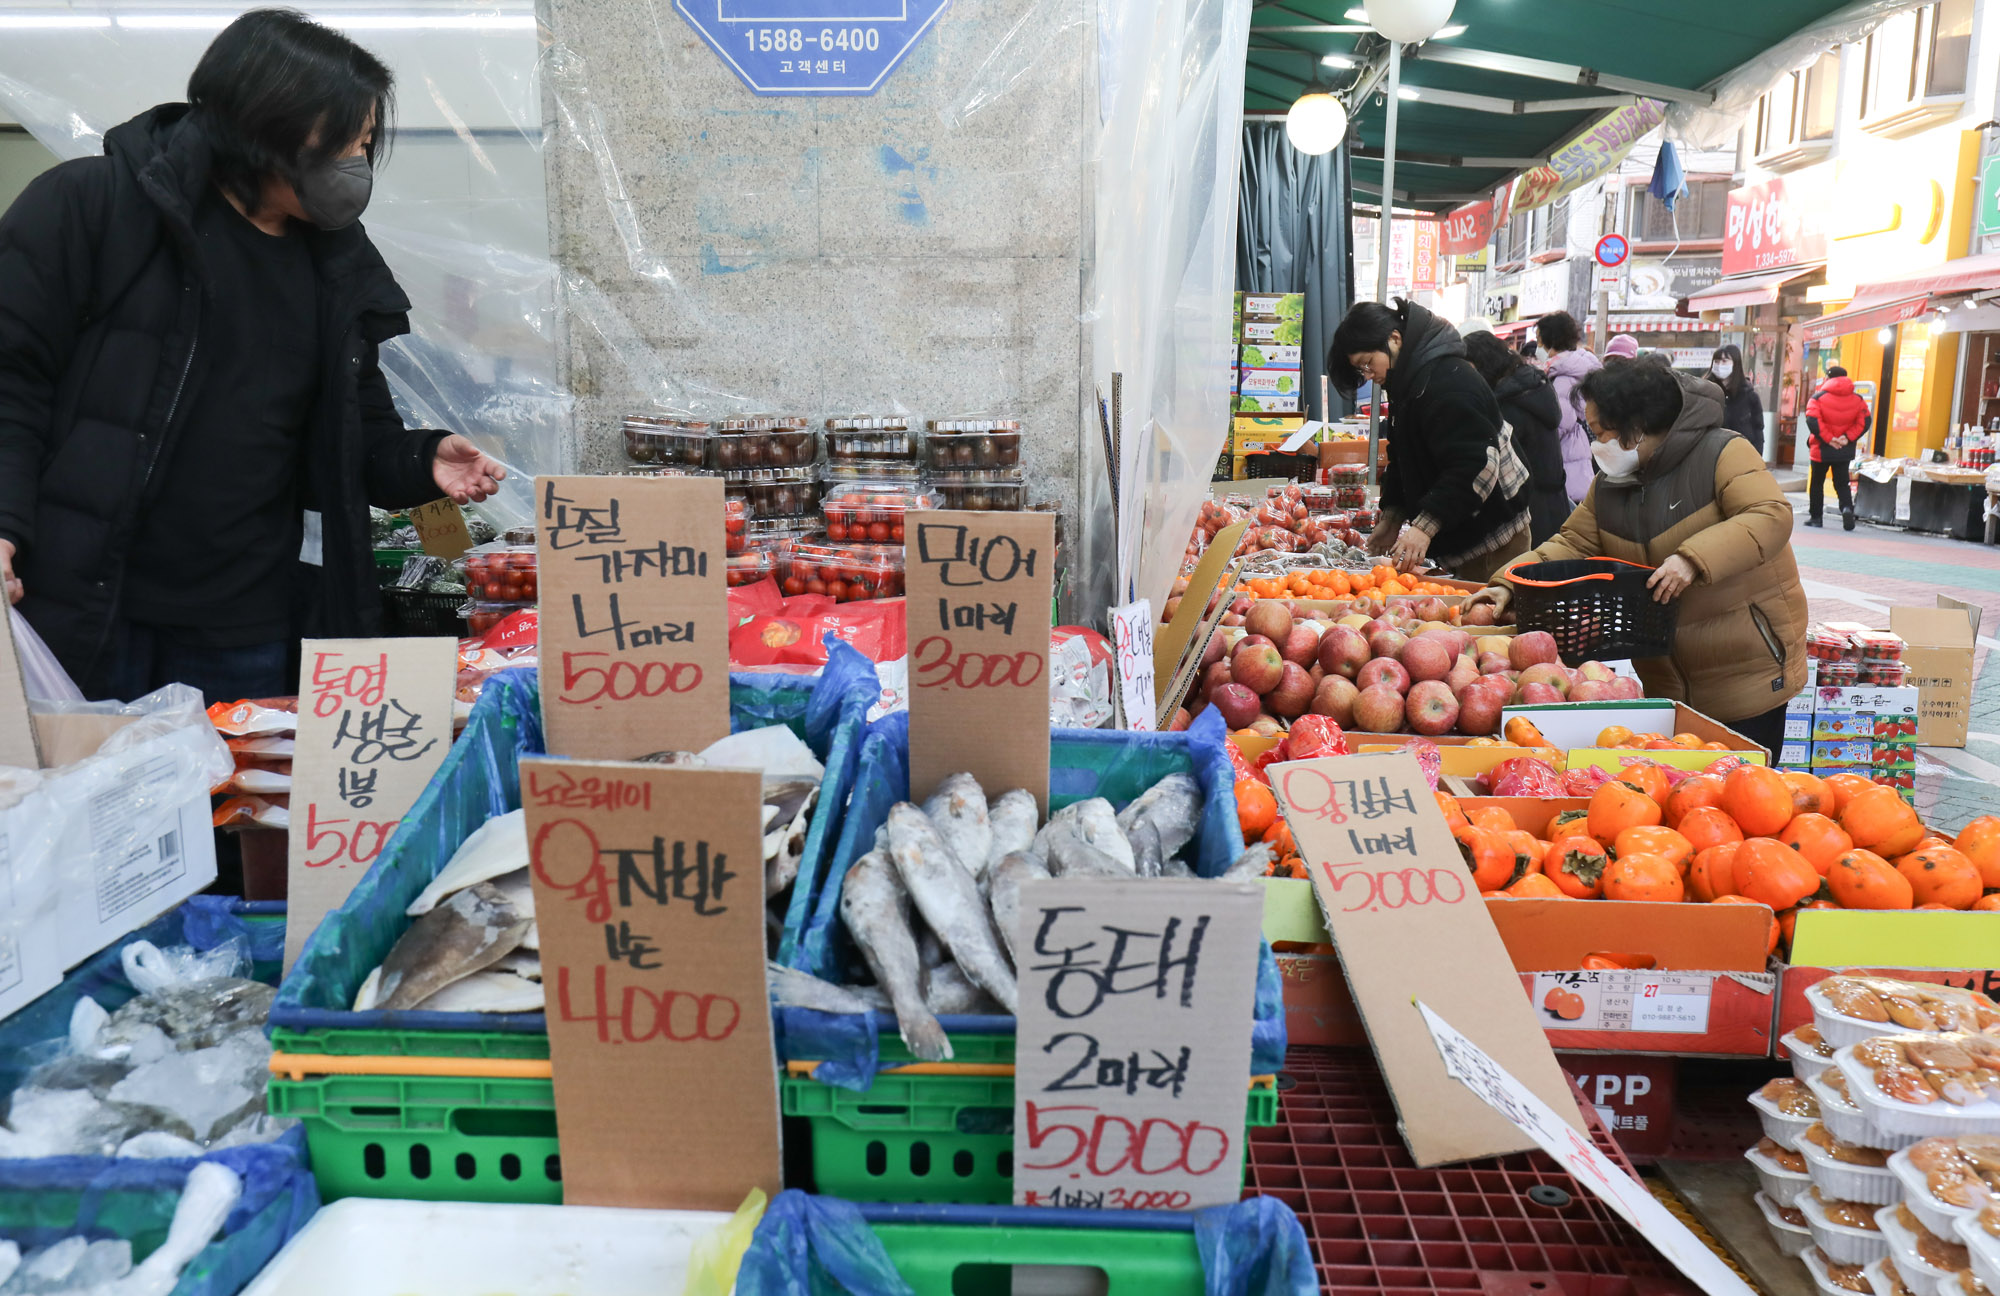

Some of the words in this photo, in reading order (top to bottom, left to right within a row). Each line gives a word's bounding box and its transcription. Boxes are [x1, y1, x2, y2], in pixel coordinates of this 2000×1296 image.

[744, 28, 879, 52] 1588-6400
[779, 59, 846, 74] 고객센터
[544, 481, 627, 550] 손질
[574, 540, 708, 584] 가자미
[917, 522, 1037, 586] 민어
[939, 598, 1018, 636] 1마리
[312, 652, 388, 718] 통영
[332, 698, 438, 764] 생굴
[529, 770, 651, 811] 노르웨이
[1282, 767, 1418, 825] 왕갈치
[1347, 826, 1418, 856] 1마리
[1029, 906, 1211, 1019] 동태
[1644, 985, 1659, 998] 27
[1603, 1012, 1629, 1020] 전화번호
[1041, 1031, 1192, 1099] 2마리
